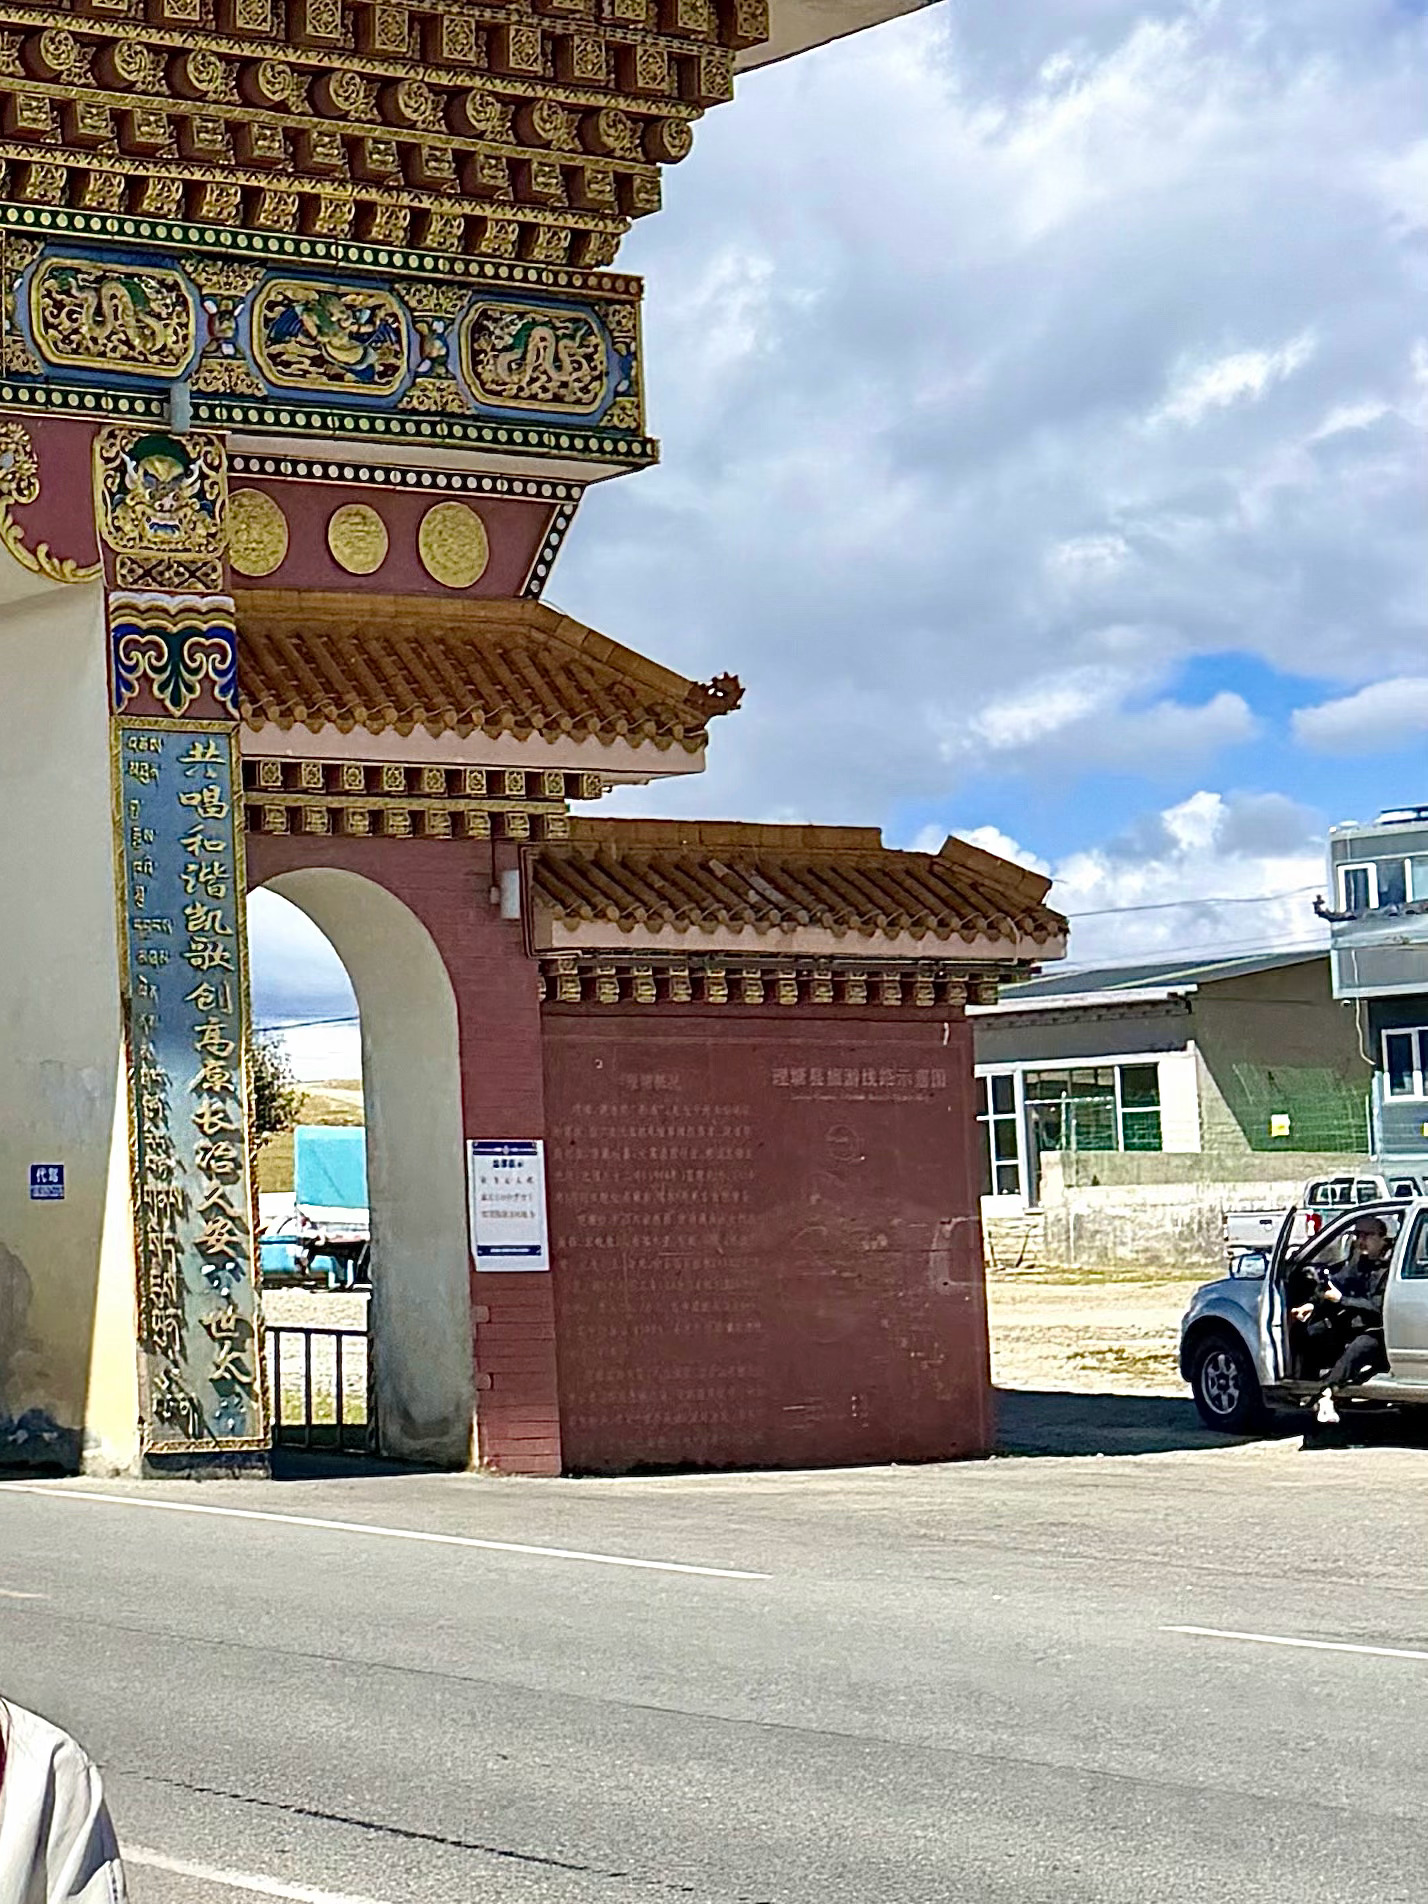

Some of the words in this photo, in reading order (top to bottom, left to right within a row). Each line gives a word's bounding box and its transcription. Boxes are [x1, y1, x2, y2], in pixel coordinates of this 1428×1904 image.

[177, 738, 254, 1430] 共唱和谐凯歌创高原长治久安世太
